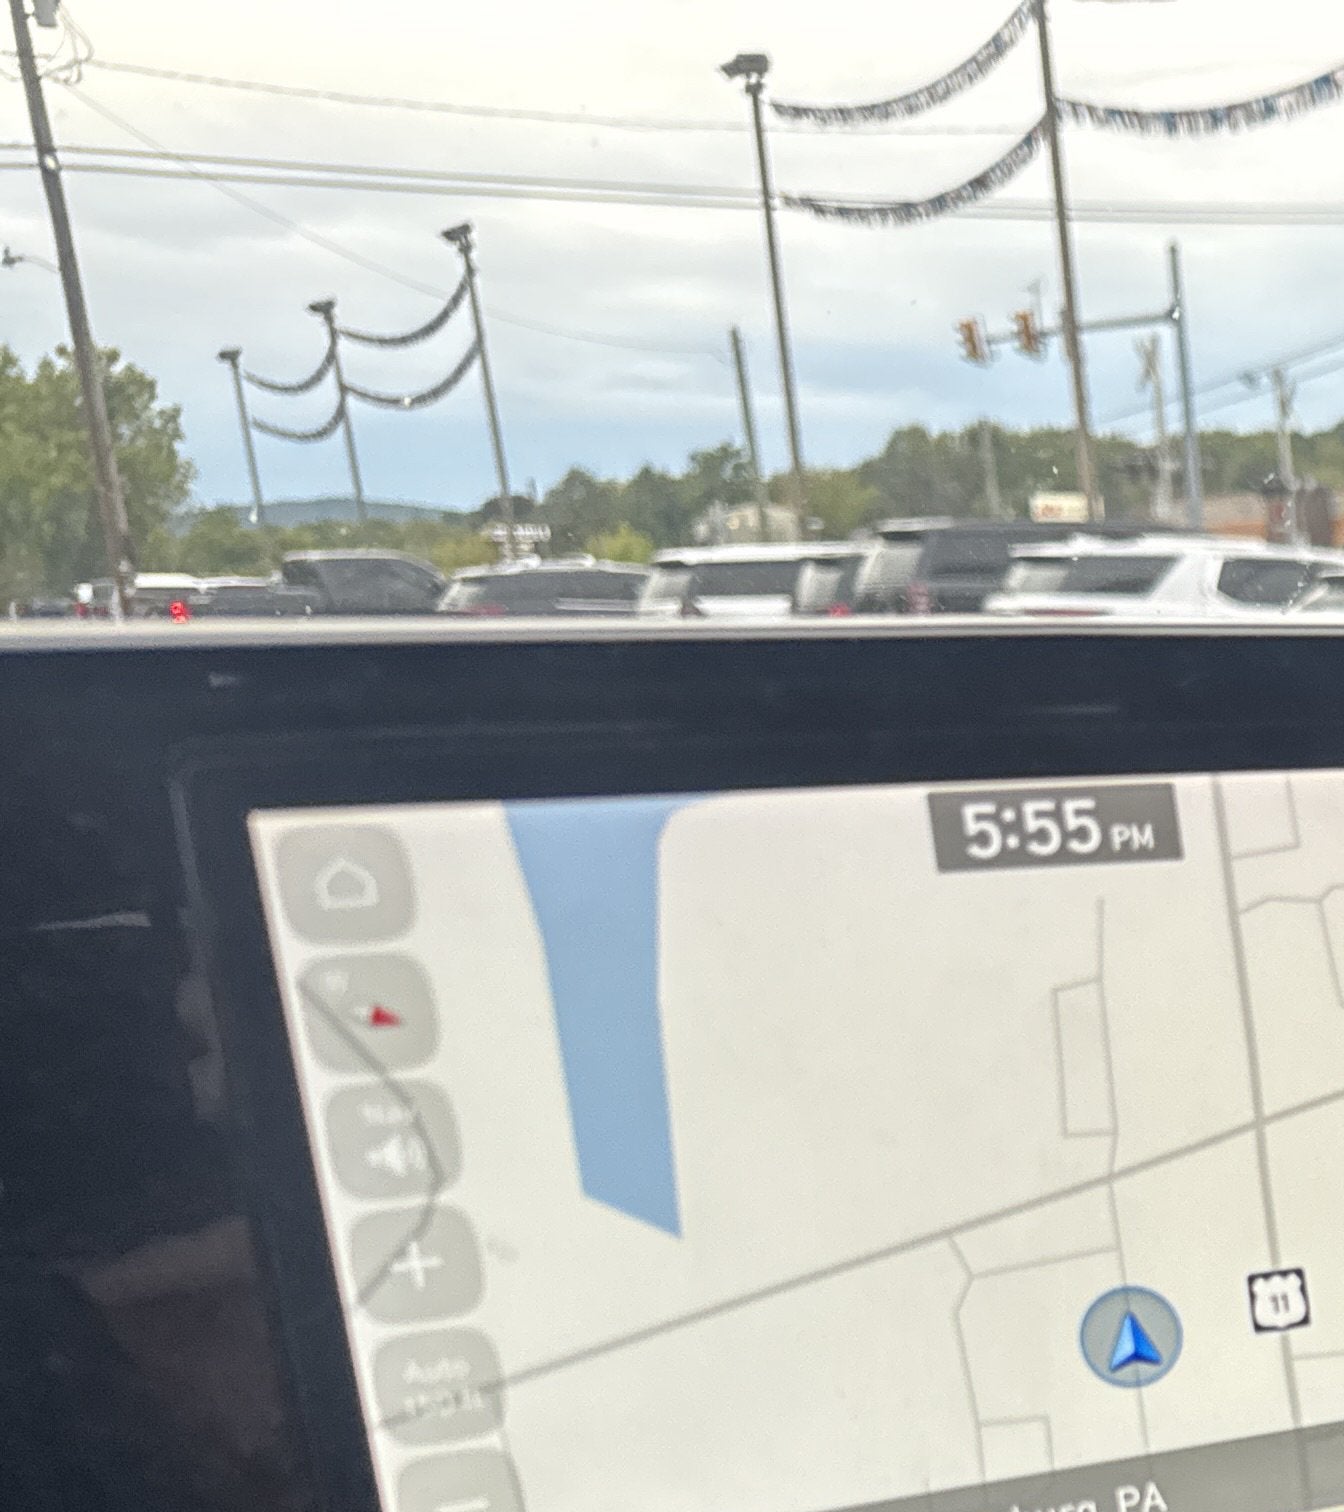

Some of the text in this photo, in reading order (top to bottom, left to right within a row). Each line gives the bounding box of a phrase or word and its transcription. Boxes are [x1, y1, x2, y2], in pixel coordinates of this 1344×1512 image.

[961, 797, 1155, 859] 5:55 PM
[1270, 1292, 1291, 1315] 11
